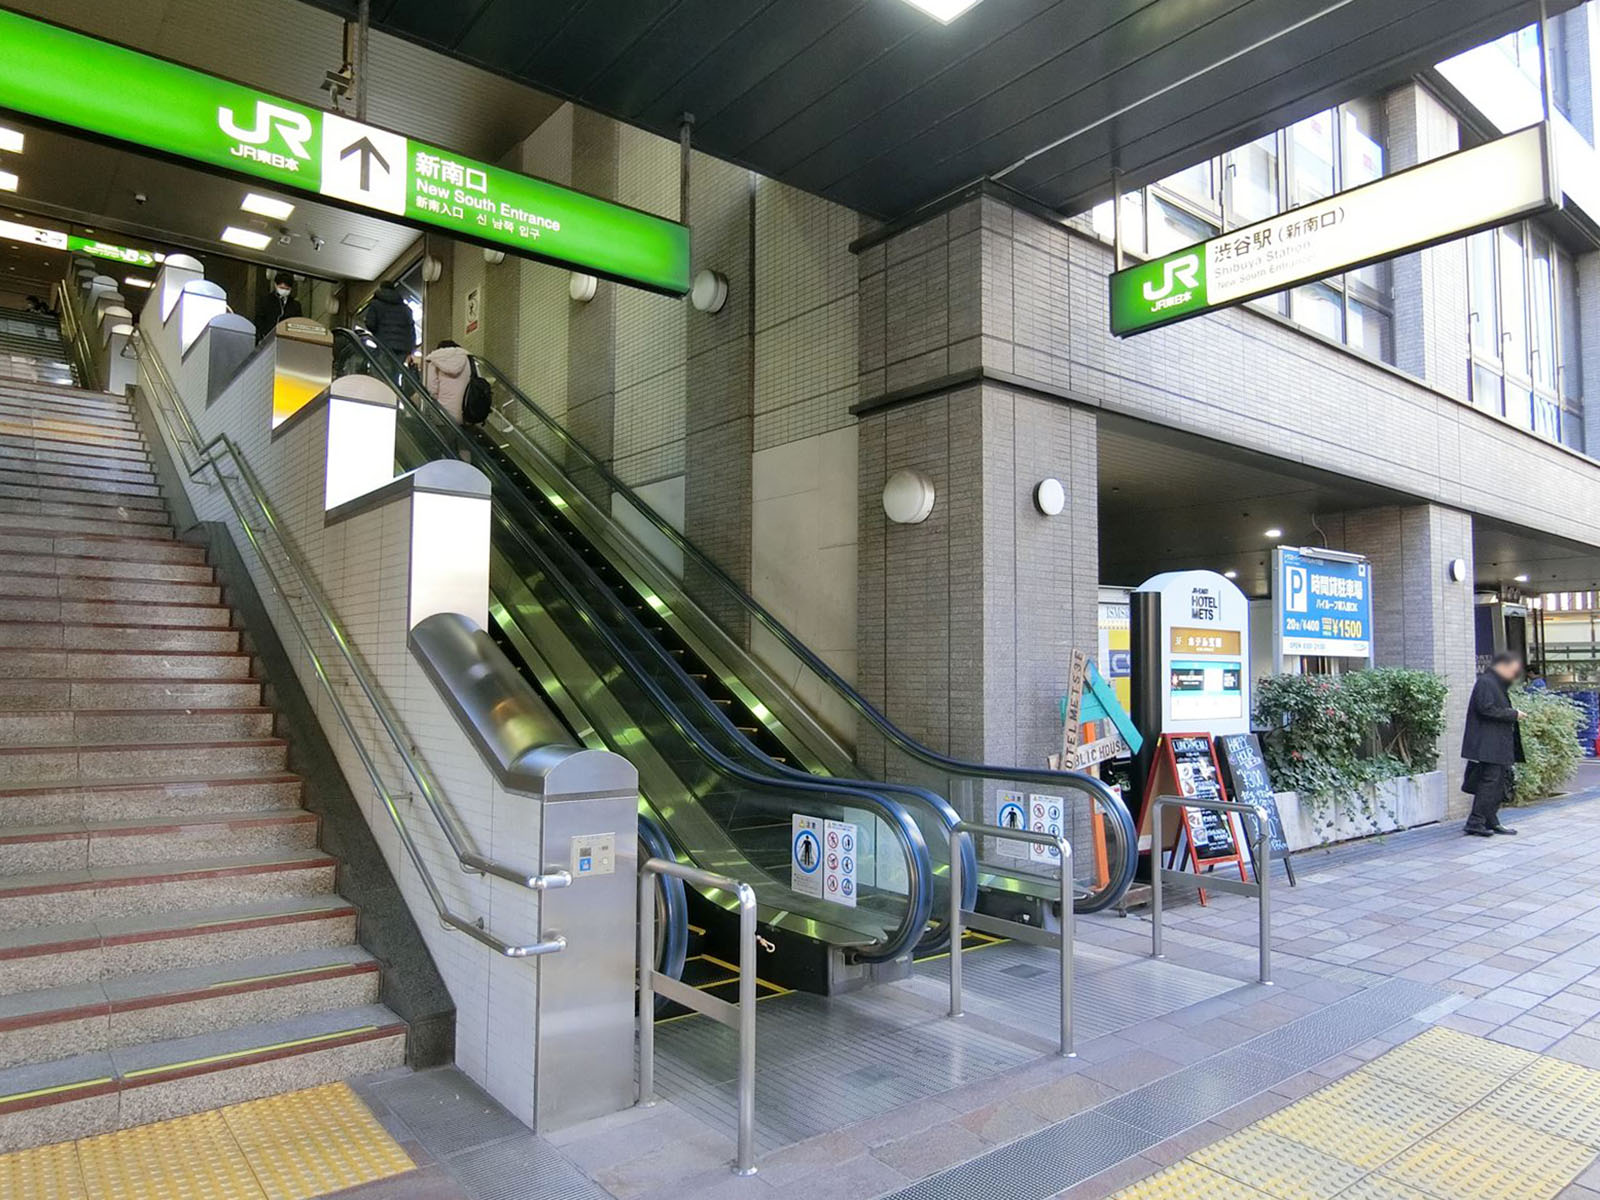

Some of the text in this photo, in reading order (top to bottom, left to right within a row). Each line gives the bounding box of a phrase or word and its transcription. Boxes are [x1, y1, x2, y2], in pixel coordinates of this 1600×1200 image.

[218, 101, 312, 160] JR
[230, 144, 299, 171] JR東日本
[416, 152, 487, 194] 新南口
[416, 178, 560, 231] New South Entrance
[416, 195, 464, 219] 新南入口
[476, 213, 487, 226] 신
[519, 226, 540, 240] 입구
[1143, 254, 1199, 300] JR
[1192, 595, 1218, 608] HOTEL
[1291, 569, 1303, 610] P
[1192, 608, 1214, 620] METS
